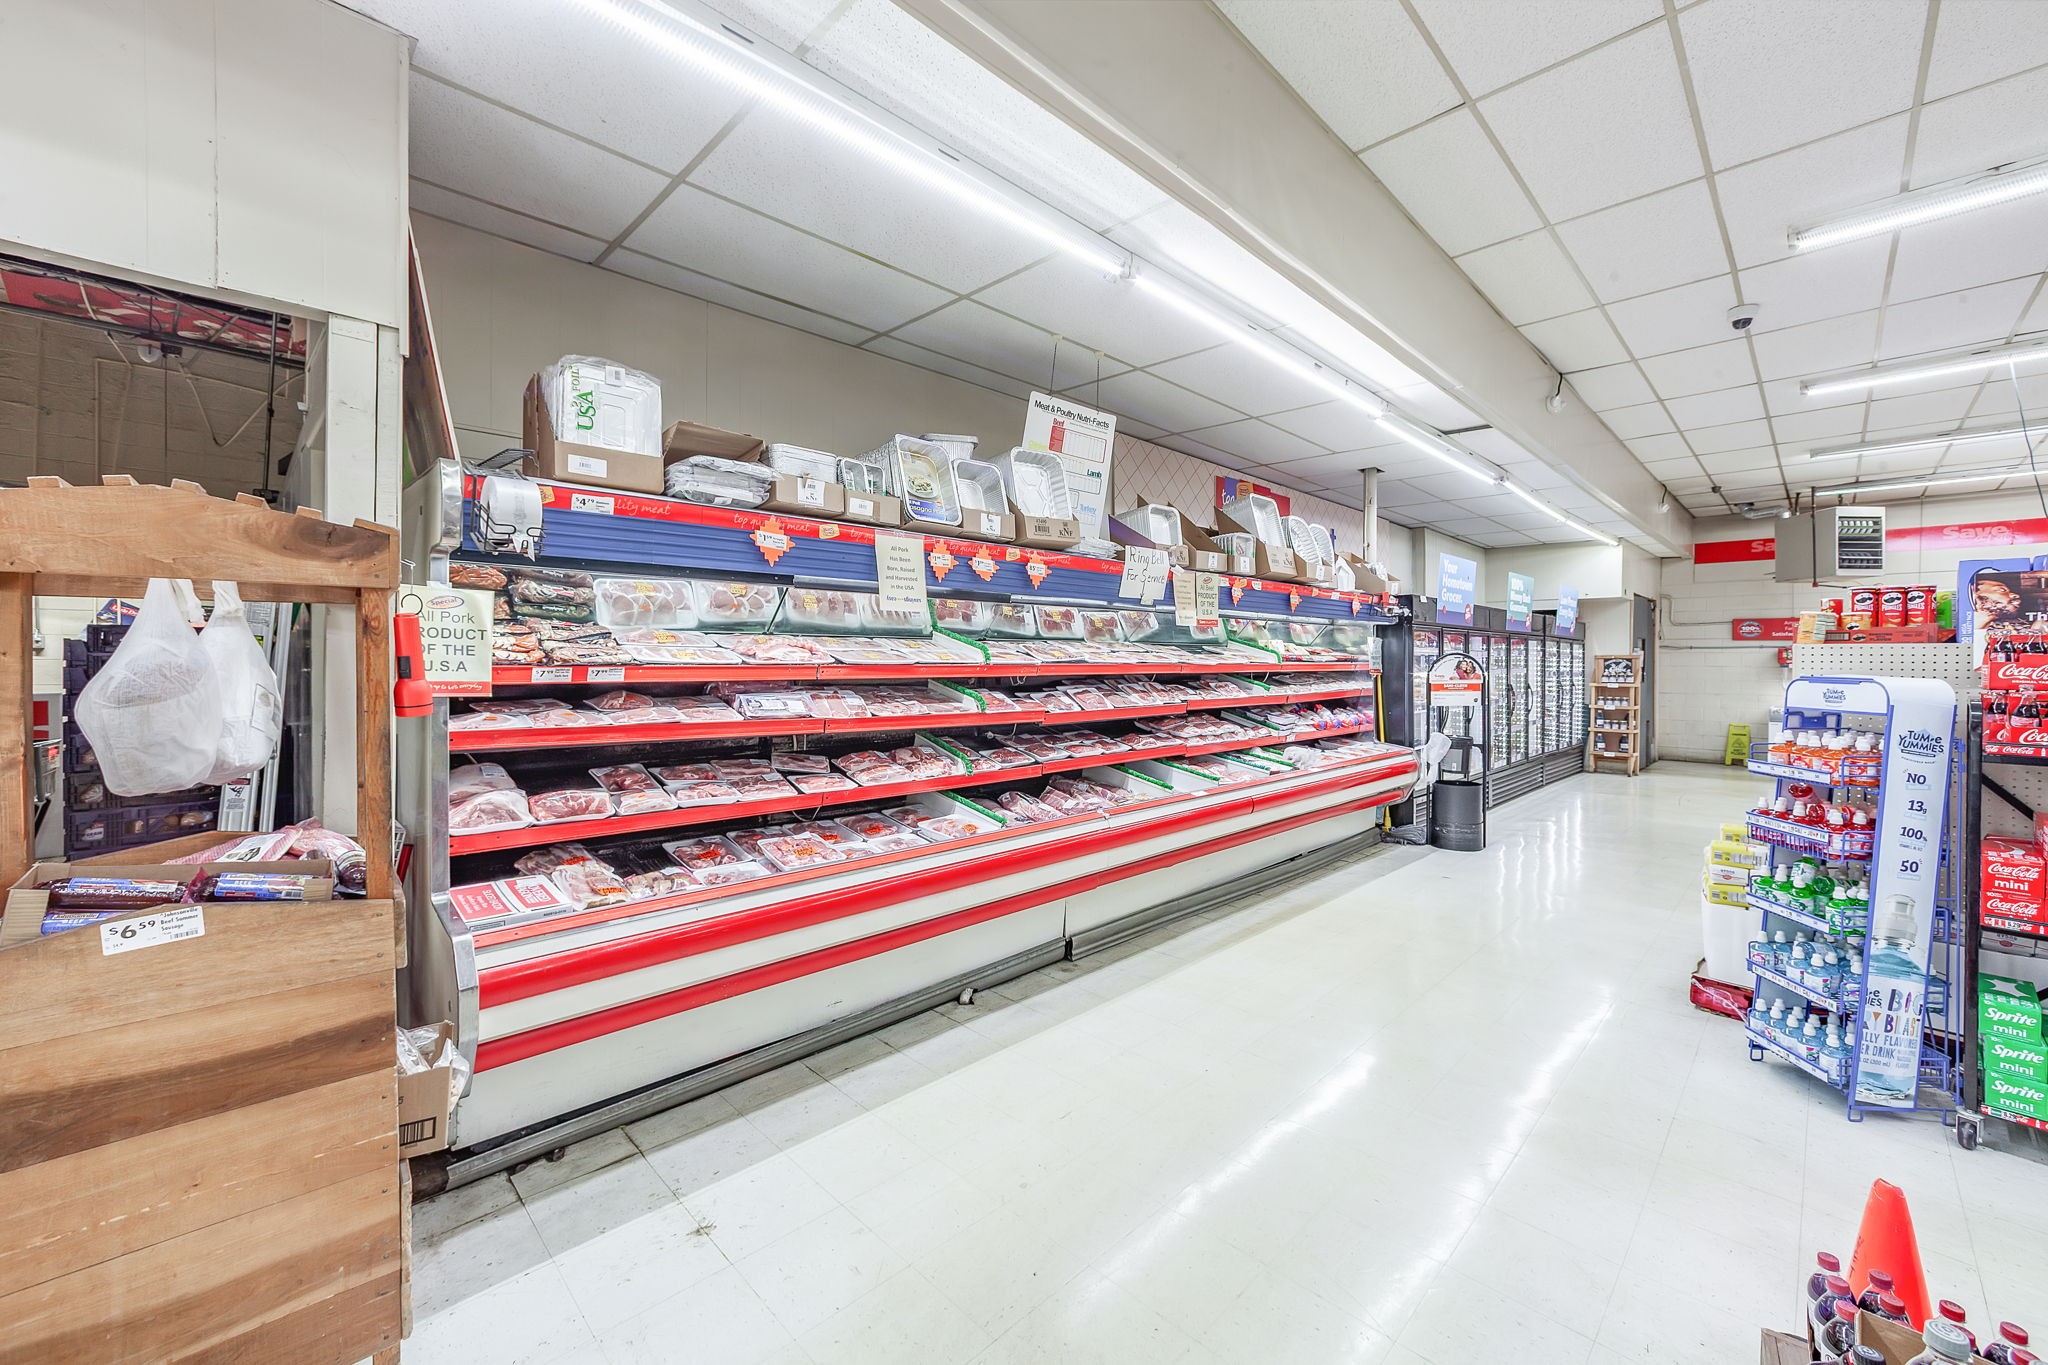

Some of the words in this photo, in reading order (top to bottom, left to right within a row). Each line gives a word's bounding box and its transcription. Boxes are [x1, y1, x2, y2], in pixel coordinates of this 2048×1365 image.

[576, 390, 597, 431] USA
[1034, 399, 1050, 412] Meat
[1050, 405, 1055, 413] &
[1056, 406, 1077, 420] Poultry
[1077, 413, 1110, 429] Nutri-Facts
[1052, 417, 1065, 427] Beef
[1086, 469, 1102, 479] Lamb
[640, 504, 672, 516] meat
[733, 512, 747, 525] top
[1129, 546, 1149, 568] Ring
[1151, 550, 1164, 566] Bell
[1443, 559, 1458, 574] Your
[1126, 568, 1138, 581] For
[1140, 568, 1165, 584] Service
[1442, 574, 1473, 592] Hometown
[1197, 592, 1217, 600] PRODUCT
[440, 611, 475, 624] Pork
[419, 627, 487, 641] RODUCT
[442, 644, 476, 656] THE
[1898, 734, 1945, 753] YUMMIES
[1906, 772, 1927, 785] NO
[1907, 800, 1927, 814] 13g
[1899, 826, 1928, 842] 100%
[1899, 860, 1919, 873] 50
[1987, 862, 2042, 879] Coca-Cola
[1994, 880, 2029, 891] mini
[1986, 898, 2041, 915] Coca-Cola
[160, 918, 174, 926] Beef
[1887, 988, 1924, 1016] BIG
[1984, 1007, 2038, 1027] Sprite
[1883, 1013, 1921, 1038] BLAST
[1993, 1024, 2027, 1038] mini
[1872, 1045, 1896, 1059] DRINK
[1991, 1044, 2045, 1064] Sprite
[2000, 1061, 2034, 1075] mini
[1991, 1080, 2045, 1100] Sprite
[2000, 1098, 2034, 1112] mini
